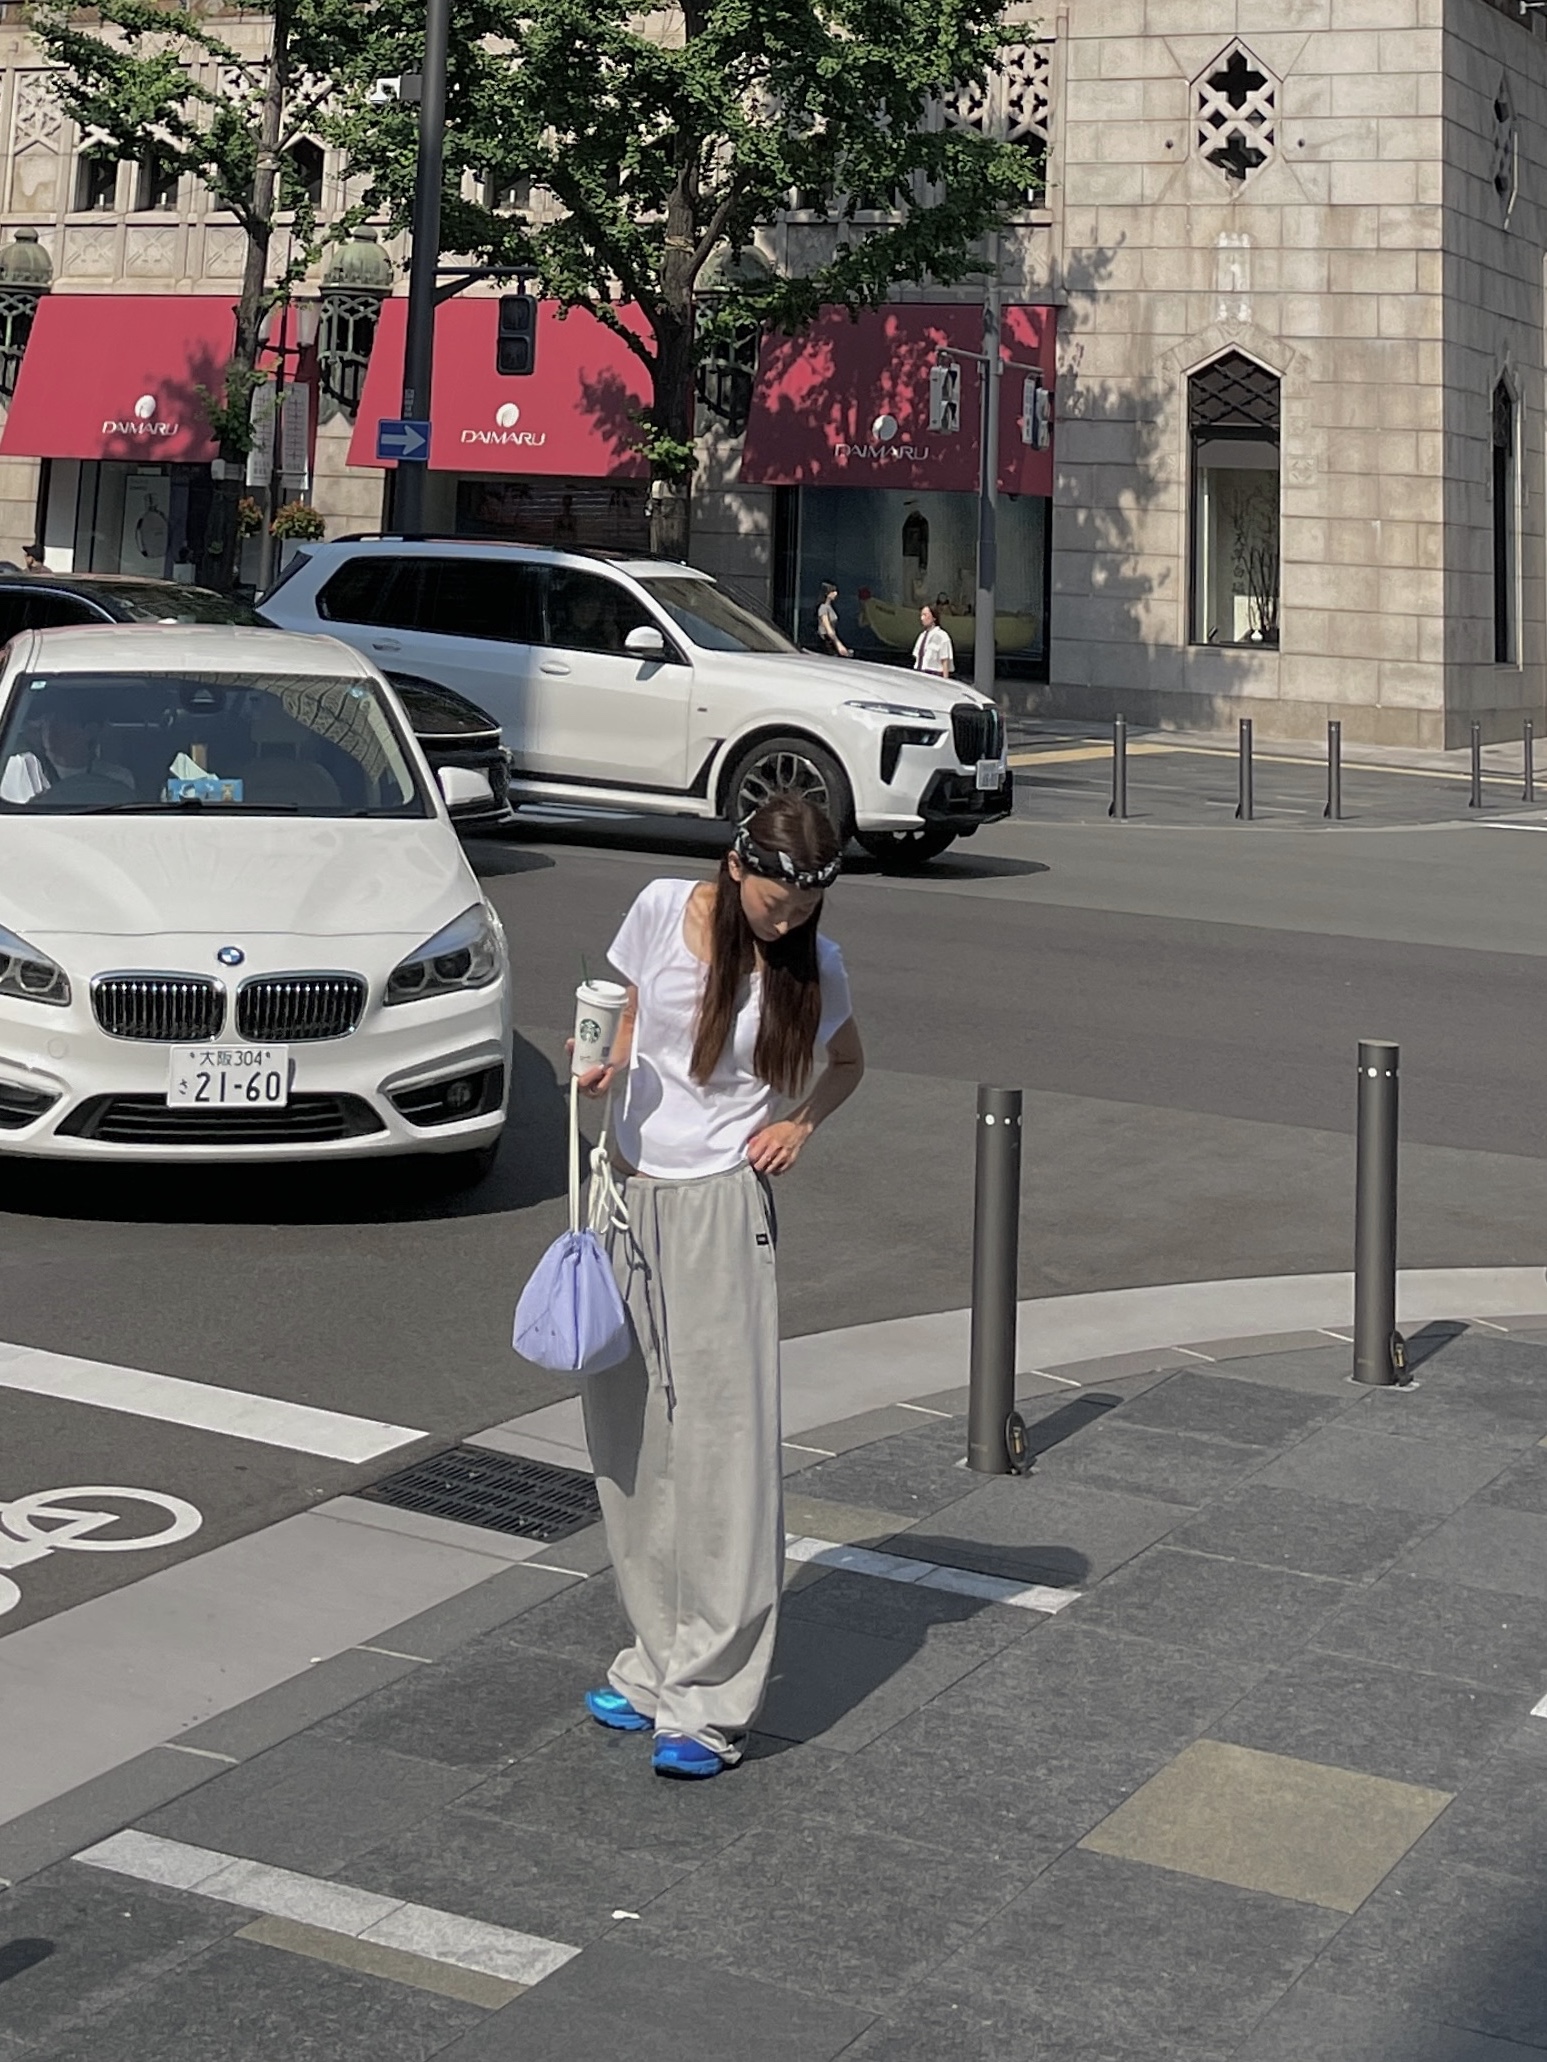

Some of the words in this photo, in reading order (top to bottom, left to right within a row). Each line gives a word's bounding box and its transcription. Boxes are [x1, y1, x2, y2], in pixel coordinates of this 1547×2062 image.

[102, 420, 179, 436] DAIMARU
[461, 430, 546, 447] DAIMARU
[834, 443, 930, 461] DAIMARU
[194, 1071, 281, 1103] 21-60
